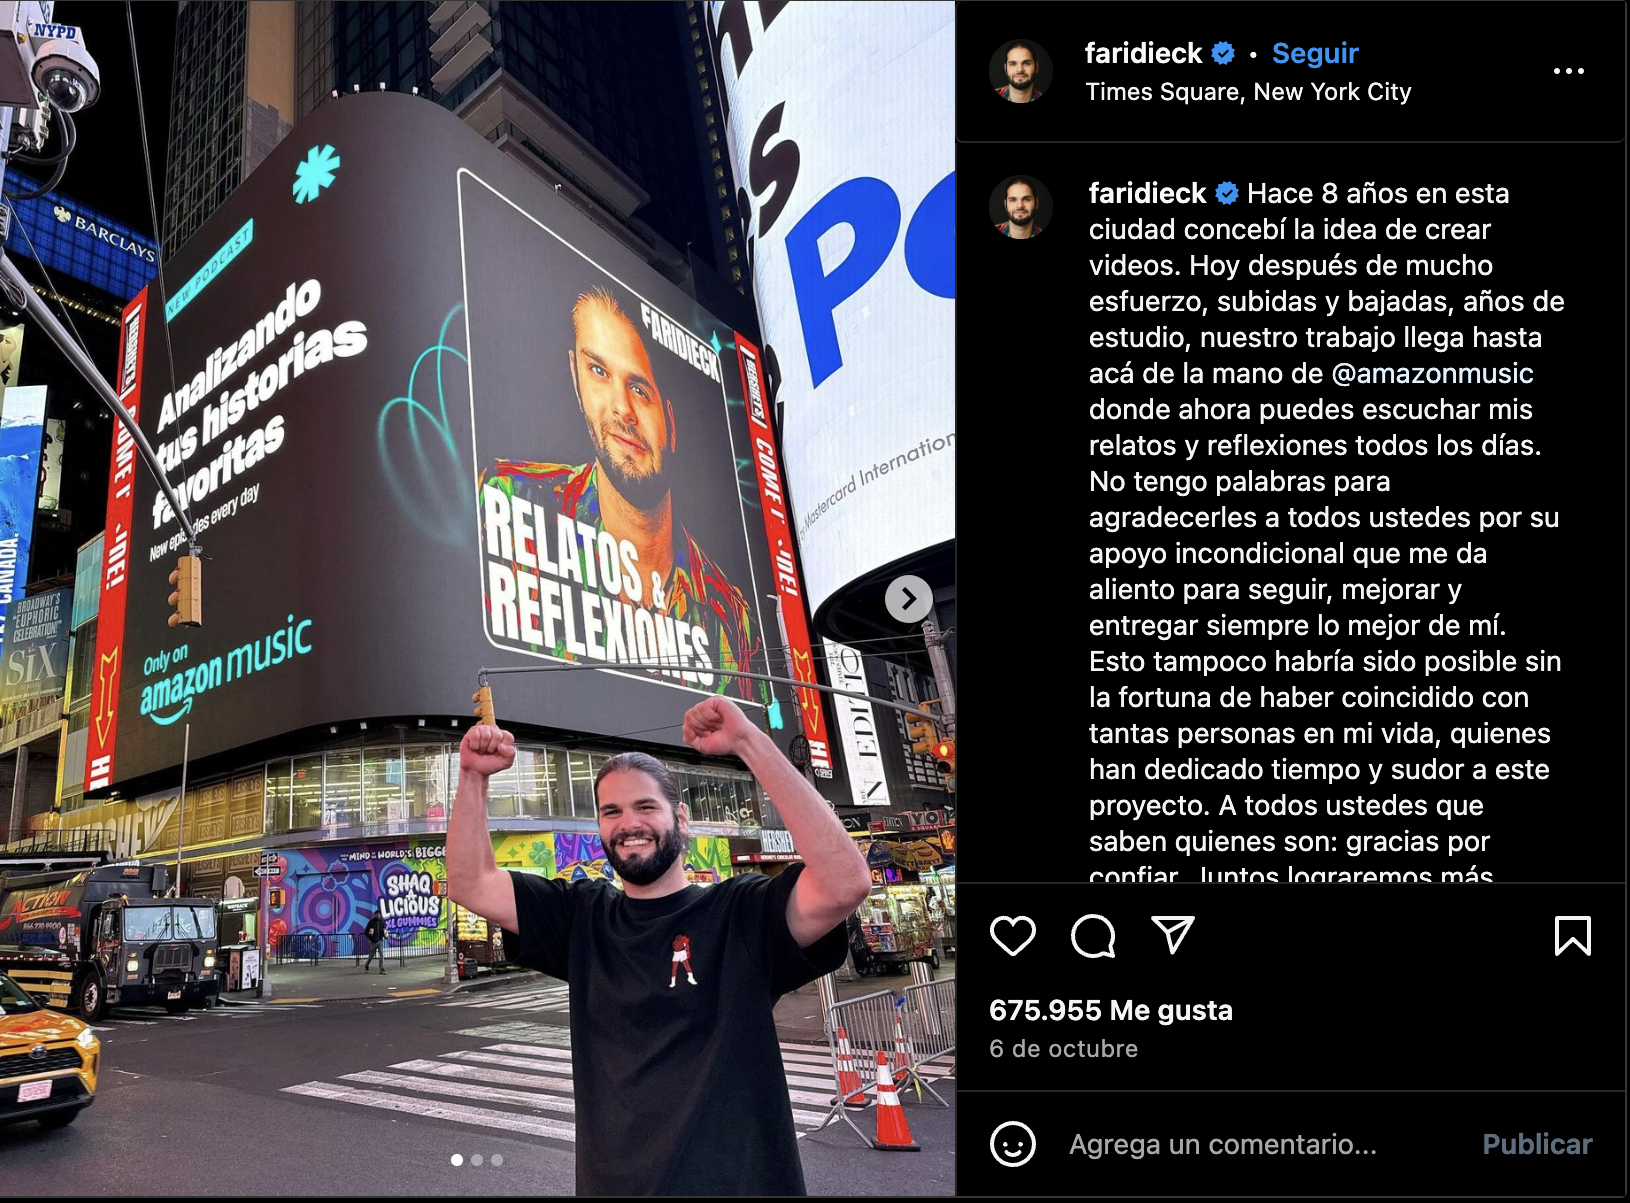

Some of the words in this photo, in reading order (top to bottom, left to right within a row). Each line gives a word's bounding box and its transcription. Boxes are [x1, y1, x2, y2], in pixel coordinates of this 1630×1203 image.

[34, 23, 76, 40] NYPD
[75, 216, 155, 263] BARCLAYS
[168, 287, 191, 315] NEW
[195, 228, 249, 289] PODCAST
[156, 278, 322, 435] Analizando
[640, 302, 722, 385] FARIDIECK
[154, 426, 198, 476] tus
[202, 320, 368, 447] historias
[152, 415, 285, 530] favoritas
[804, 474, 858, 532] Mastercard
[149, 538, 168, 563] New
[169, 514, 210, 551] episdes
[211, 496, 239, 525] every
[240, 483, 260, 507] day
[482, 483, 642, 599] RELATOS
[651, 571, 666, 609] &
[17, 592, 61, 612] BROADWAY'S
[488, 560, 715, 688] REFLEXIONES
[140, 660, 223, 717] amazon
[226, 613, 313, 682] music
[143, 647, 169, 676] Only
[171, 642, 188, 663] on
[349, 852, 371, 861] MIND
[378, 850, 412, 859] WORLD'S
[386, 874, 430, 897] SHAQ
[379, 896, 440, 919] LICIOUS
[397, 916, 437, 928] GUMMIES
